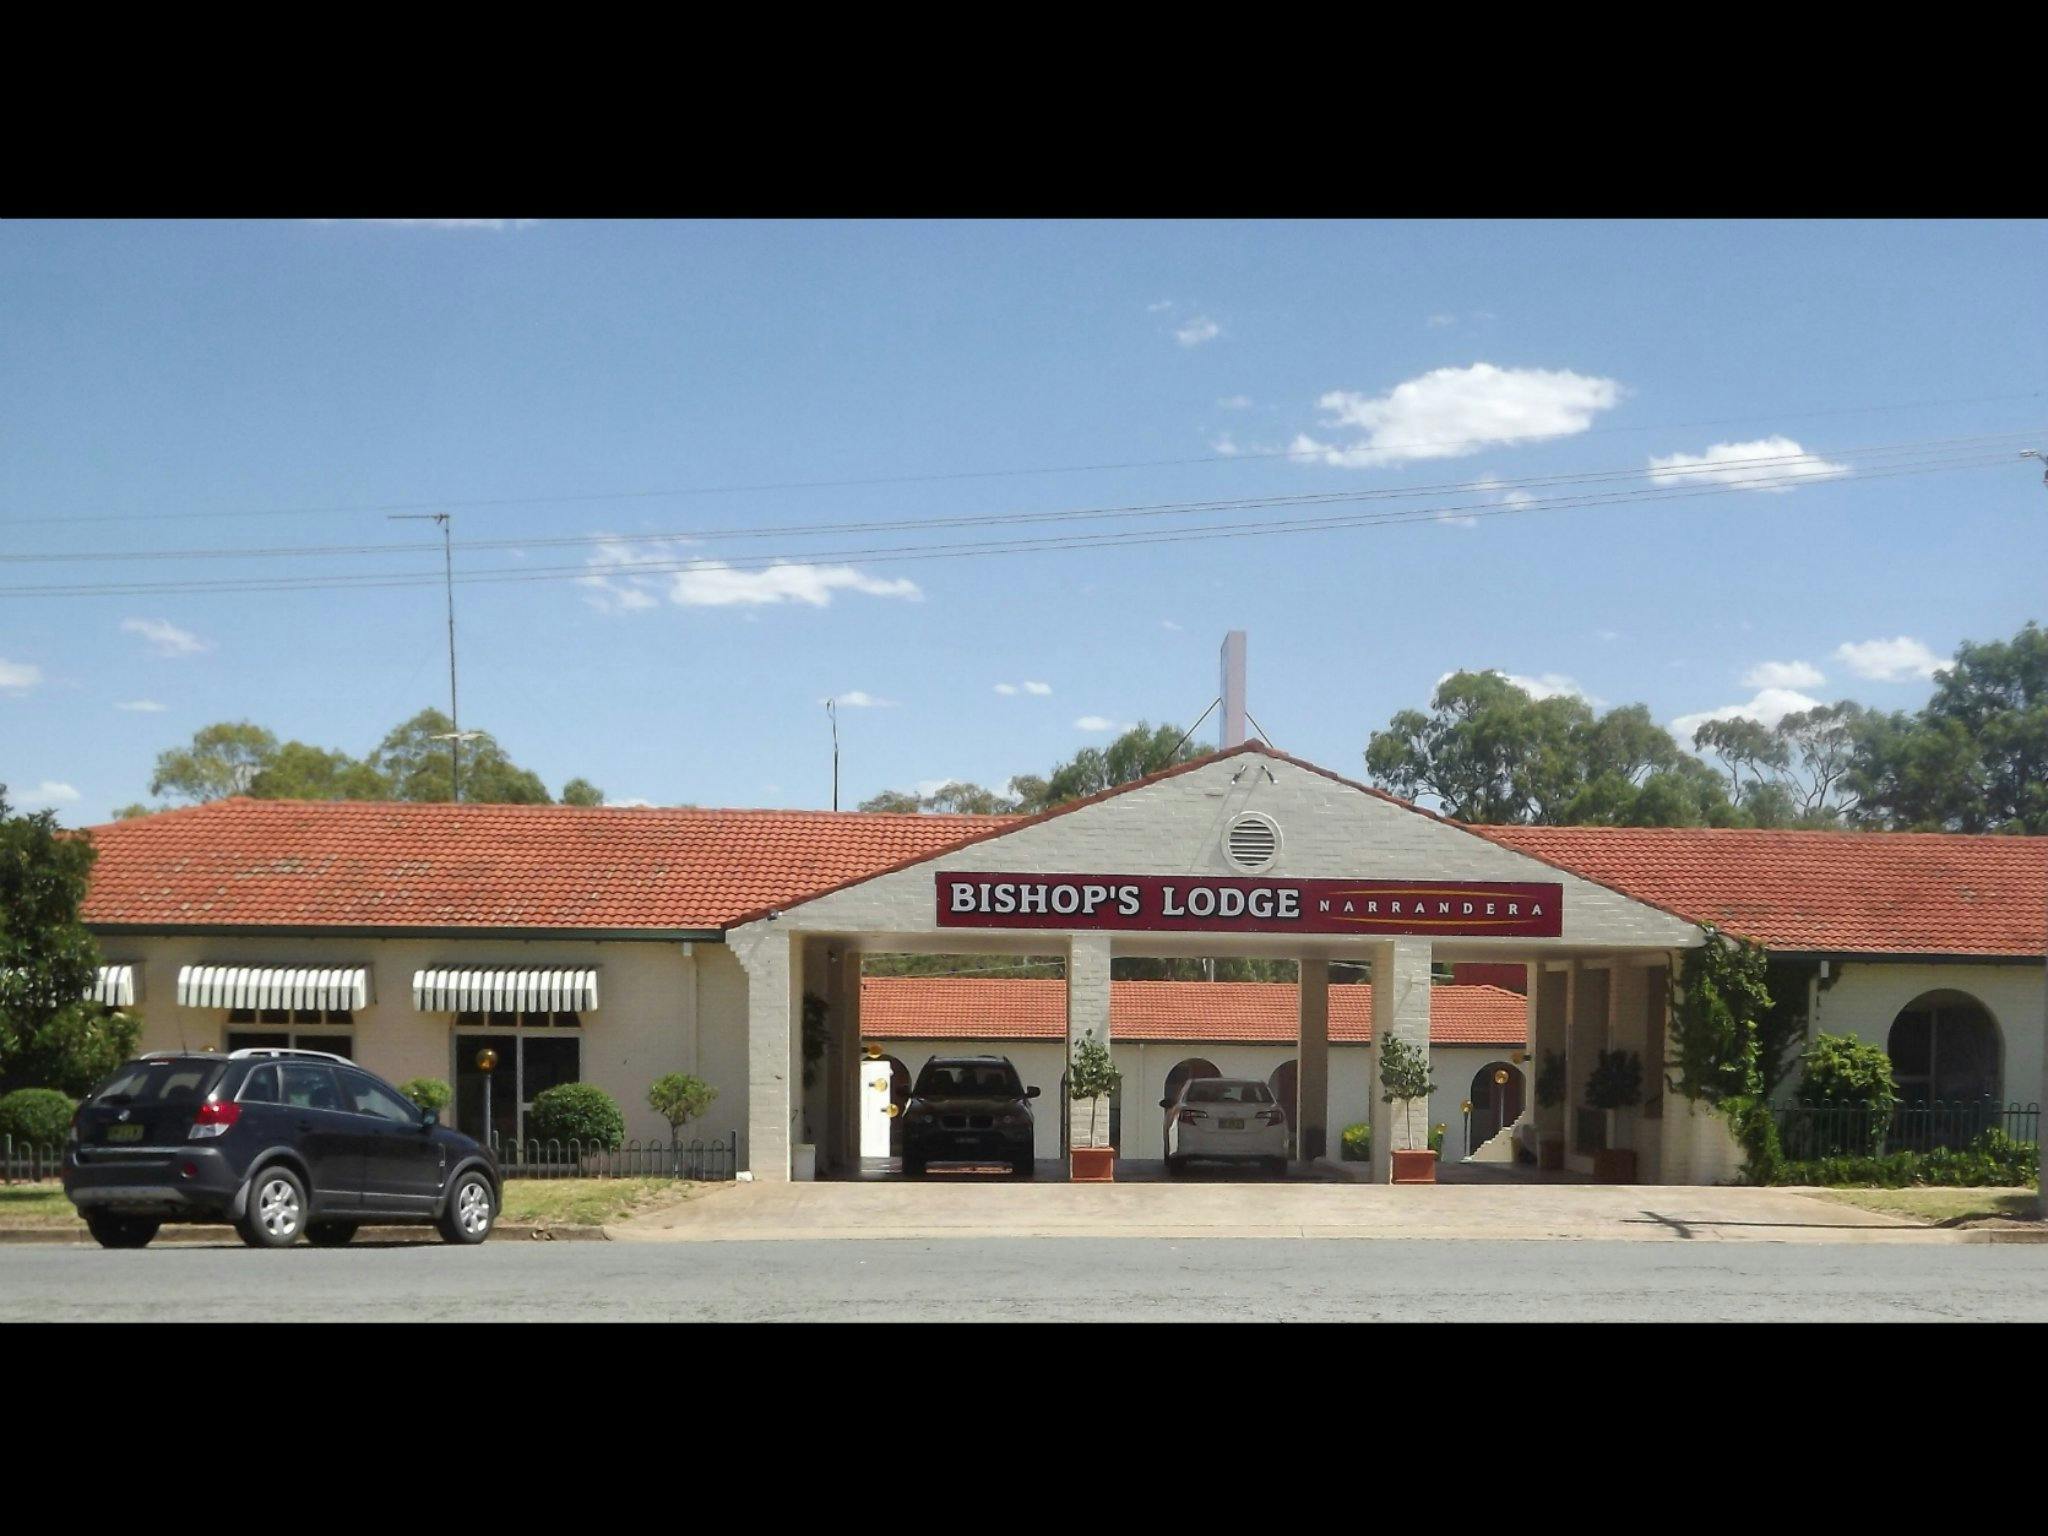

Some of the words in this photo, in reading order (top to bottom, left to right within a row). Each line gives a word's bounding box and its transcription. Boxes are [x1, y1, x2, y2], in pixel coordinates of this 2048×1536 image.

[951, 883, 1140, 915] BISHOP'S
[1162, 887, 1300, 917] LODGE
[1319, 900, 1542, 915] NARRANDERA
